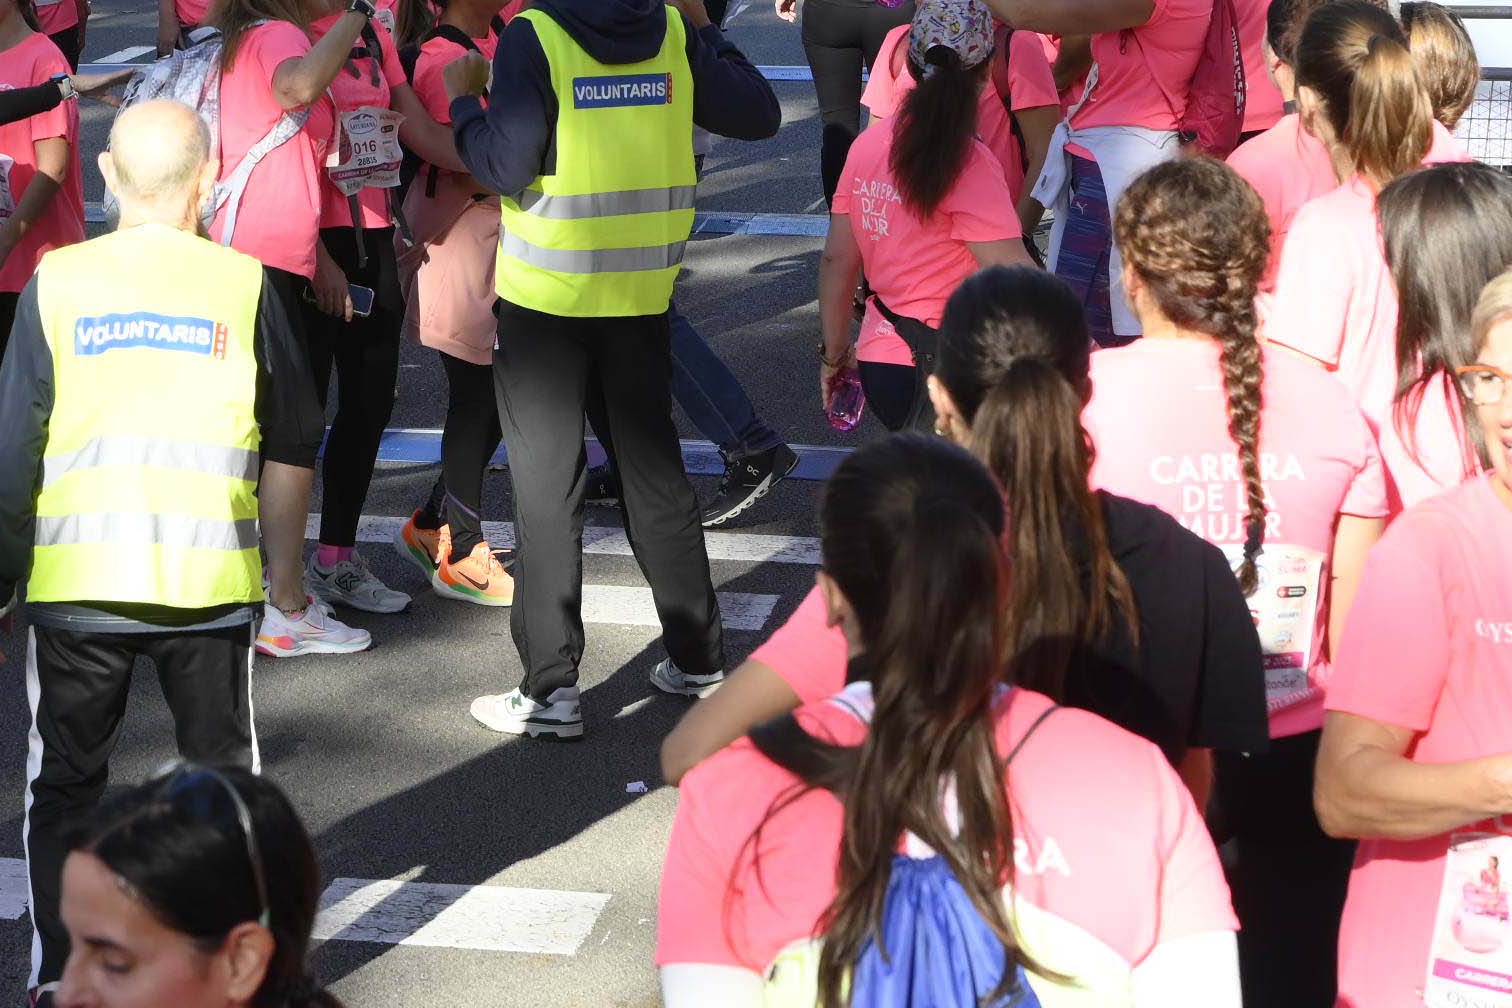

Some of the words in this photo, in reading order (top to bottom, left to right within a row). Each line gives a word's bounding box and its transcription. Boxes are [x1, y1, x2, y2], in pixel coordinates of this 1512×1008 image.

[575, 82, 667, 101] VOLUNTARIS
[353, 140, 377, 155] 016
[77, 319, 213, 347] VOLUNTARIS
[1149, 454, 1305, 484] CARRRA
[1182, 484, 1225, 512] DE
